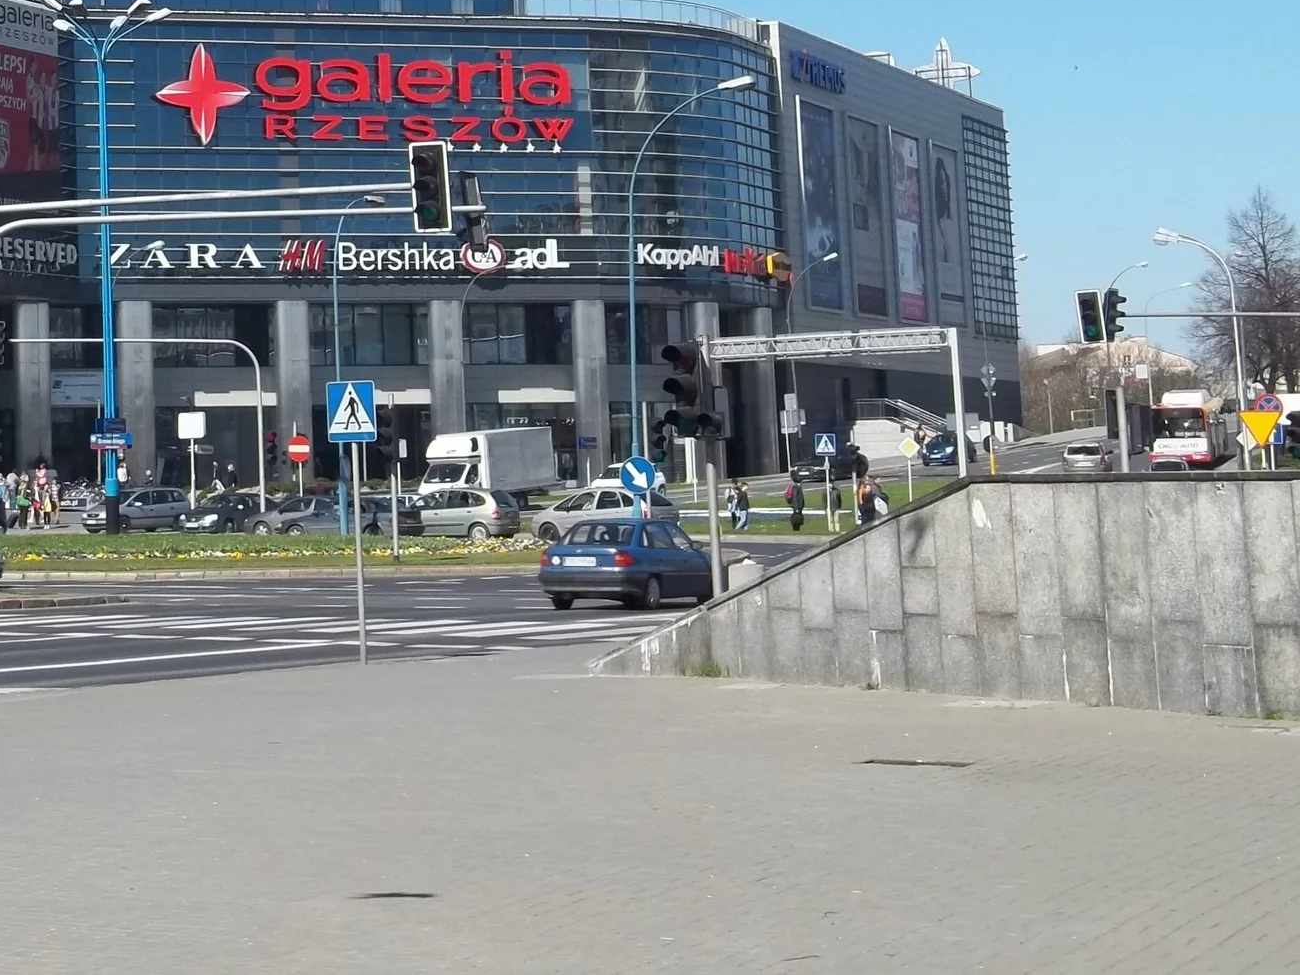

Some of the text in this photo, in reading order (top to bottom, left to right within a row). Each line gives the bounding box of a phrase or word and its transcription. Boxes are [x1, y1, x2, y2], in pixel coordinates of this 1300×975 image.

[255, 50, 572, 110] galeria
[265, 107, 574, 143] RZESZÓW
[110, 242, 266, 268] ZARA
[278, 239, 324, 272] H&M
[338, 241, 455, 271] Bershka
[637, 243, 720, 270] KappAhl
